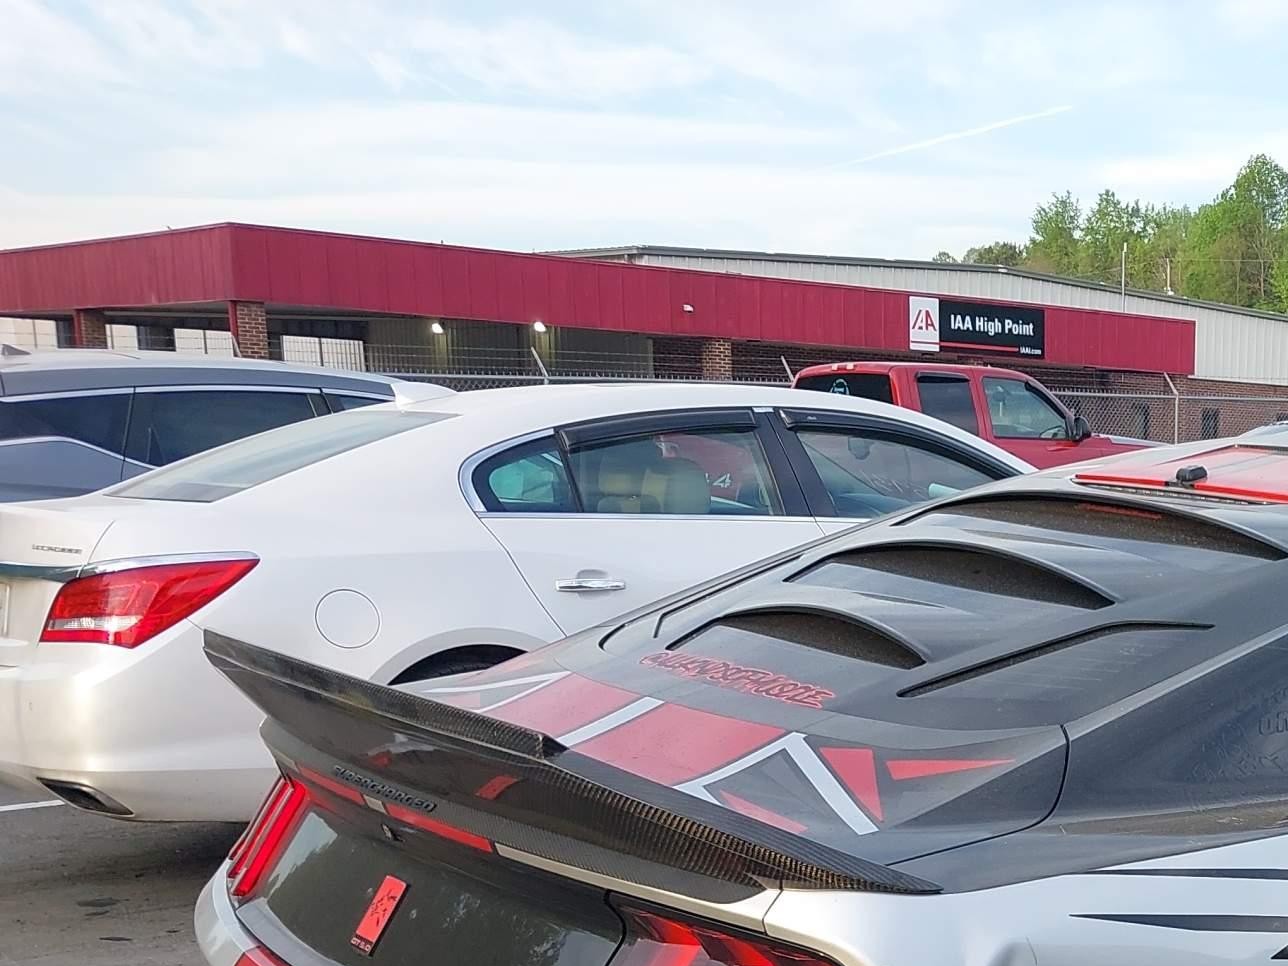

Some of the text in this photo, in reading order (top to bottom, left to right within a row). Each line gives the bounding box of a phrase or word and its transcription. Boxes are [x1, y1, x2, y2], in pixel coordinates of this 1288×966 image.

[950, 314, 1034, 336] IAA High Point
